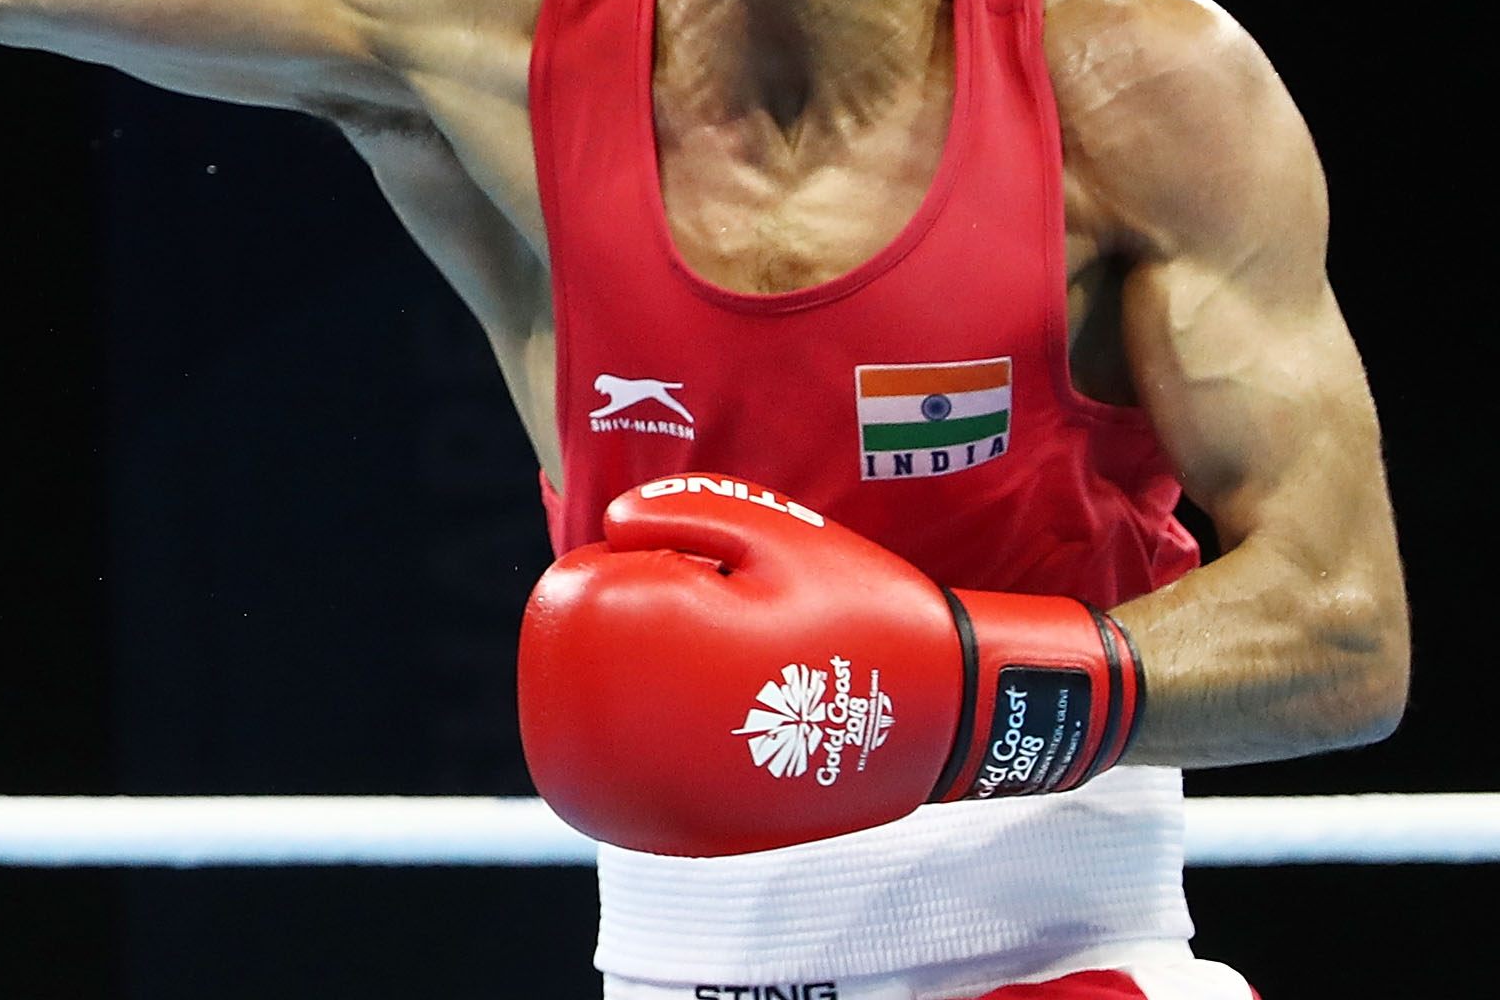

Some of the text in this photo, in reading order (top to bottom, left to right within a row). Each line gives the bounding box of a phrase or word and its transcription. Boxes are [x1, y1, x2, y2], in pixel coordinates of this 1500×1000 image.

[590, 418, 695, 440] SHIV-NARESH
[866, 436, 1004, 477] INDIA
[640, 477, 825, 527] STING
[816, 655, 851, 786] Gold Coast
[845, 697, 869, 746] 2018
[979, 688, 1028, 797] old Coast
[1008, 735, 1045, 781] 2018
[696, 982, 837, 1000] STING
